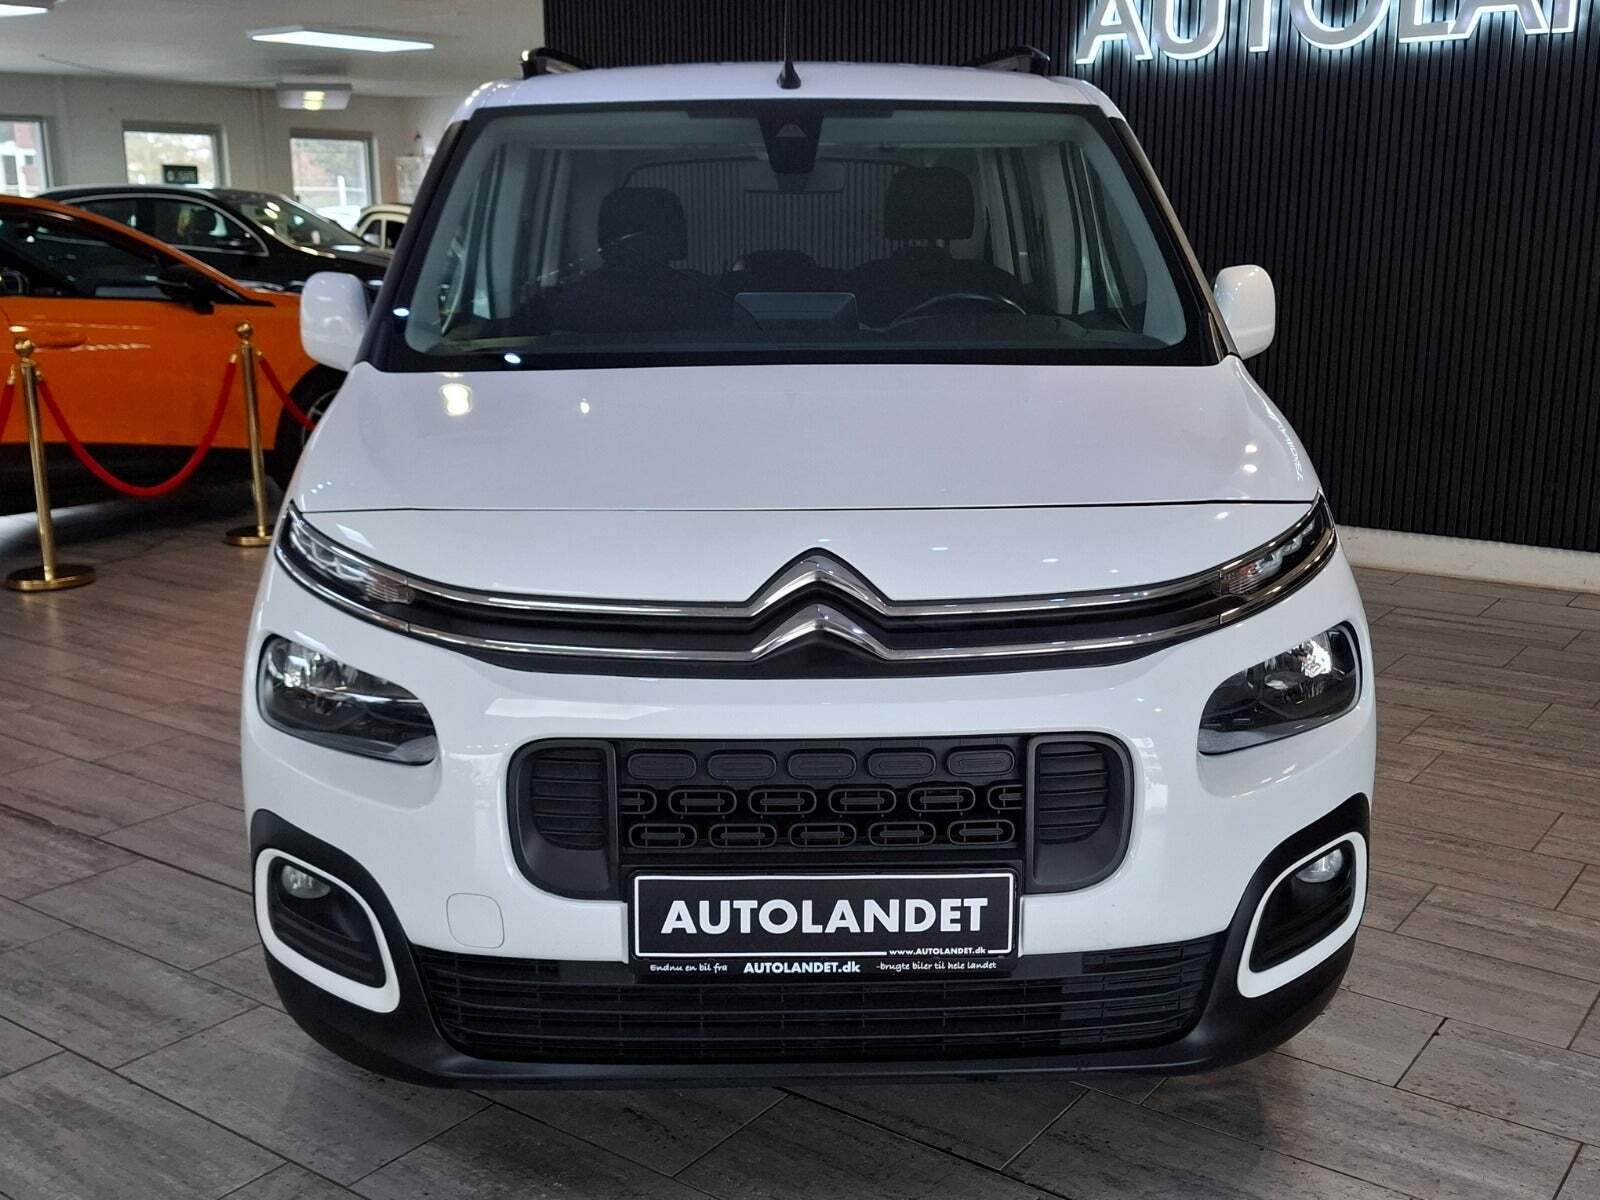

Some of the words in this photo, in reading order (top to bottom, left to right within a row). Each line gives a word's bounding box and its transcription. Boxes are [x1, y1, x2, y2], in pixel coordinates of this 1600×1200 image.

[661, 897, 988, 934] AUTOLANDET
[889, 946, 986, 955] www.AUTOLANDET.dk
[700, 963, 711, 972] bil
[713, 964, 728, 974] fra
[743, 961, 861, 974] AUTOLANDET.dk
[912, 961, 932, 970] biler
[934, 960, 945, 969] til
[947, 961, 965, 969] hele
[967, 960, 997, 969] landet
